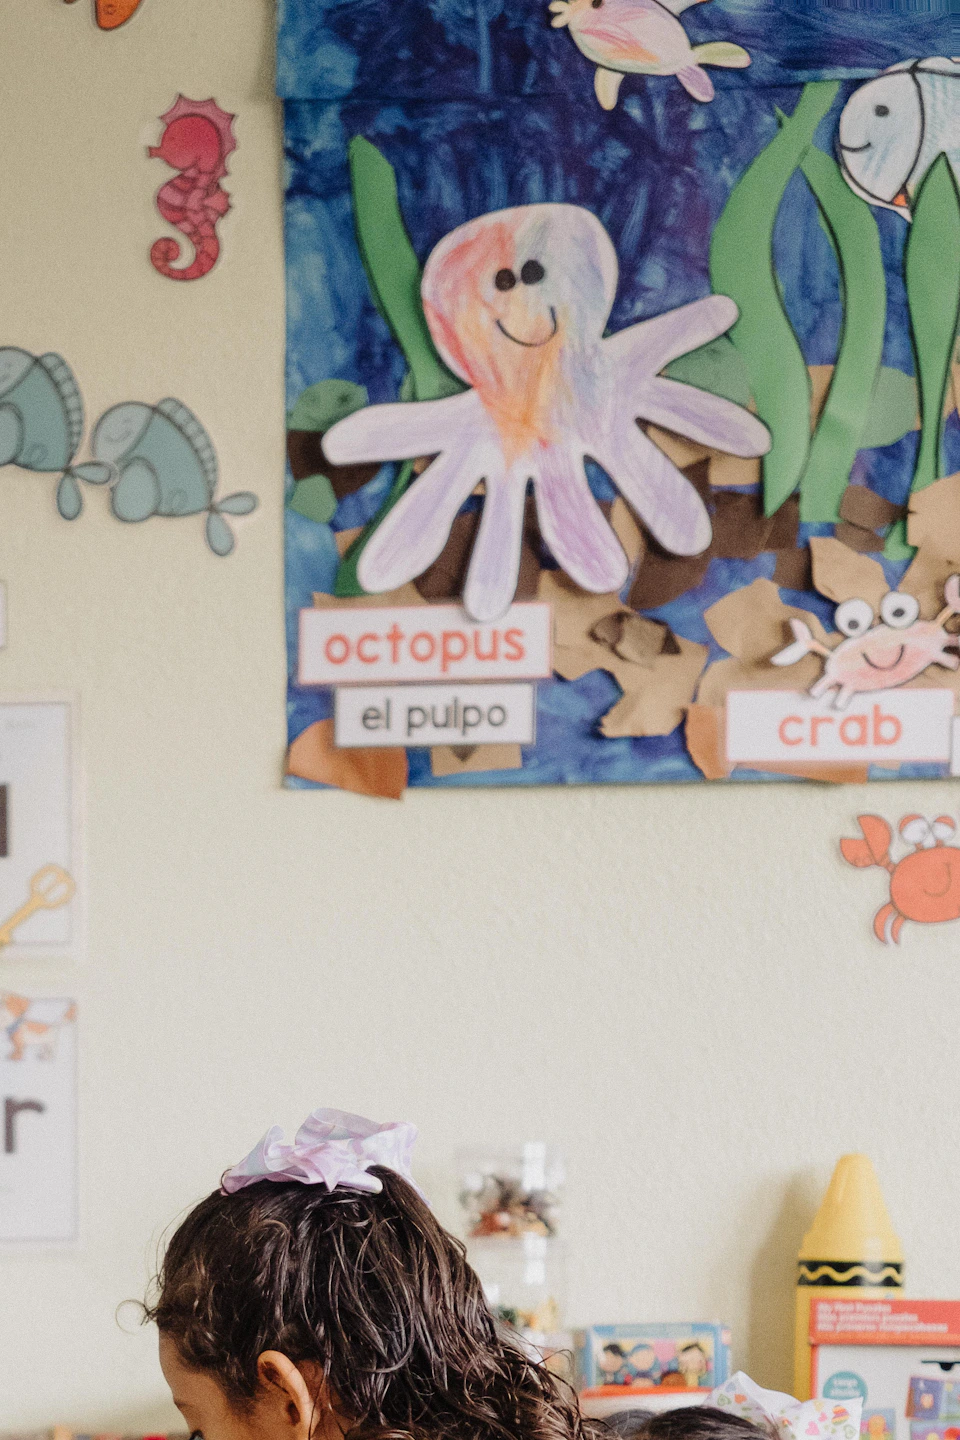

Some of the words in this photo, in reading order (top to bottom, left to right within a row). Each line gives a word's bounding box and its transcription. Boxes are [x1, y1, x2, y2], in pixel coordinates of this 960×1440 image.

[325, 623, 526, 673] octopus
[362, 699, 391, 730] el
[407, 696, 508, 736] pulpo
[777, 703, 904, 747] crab
